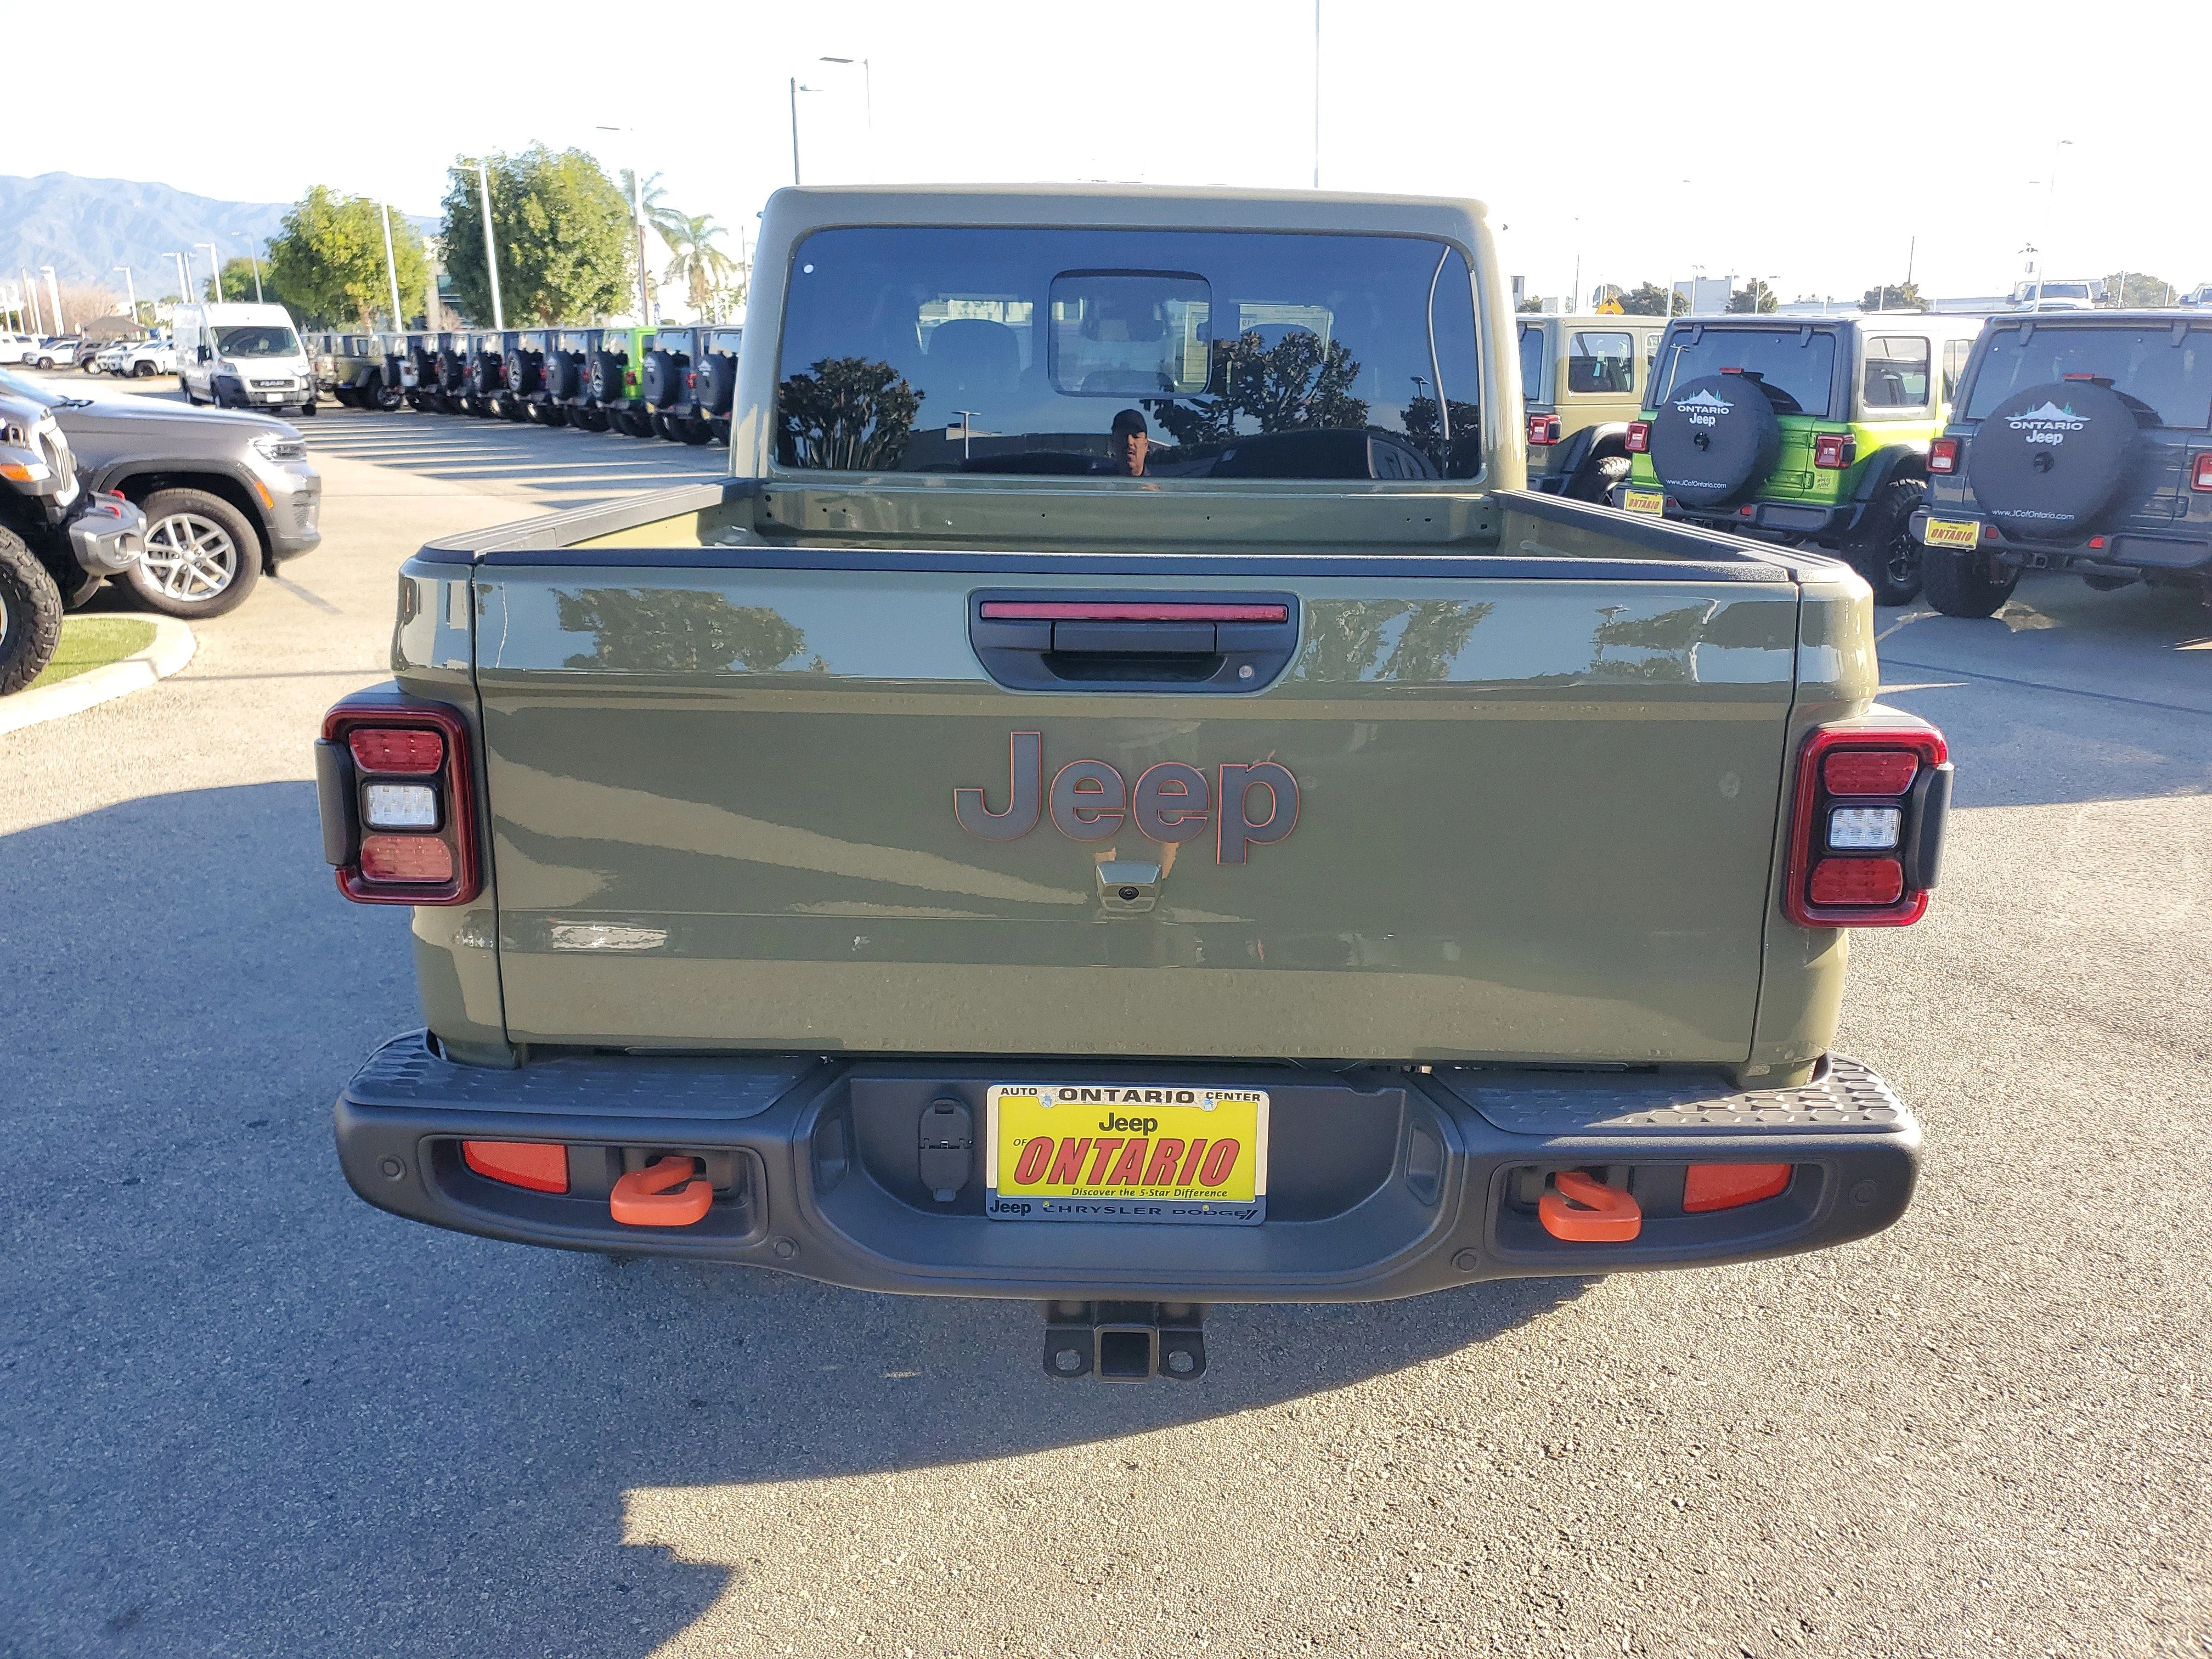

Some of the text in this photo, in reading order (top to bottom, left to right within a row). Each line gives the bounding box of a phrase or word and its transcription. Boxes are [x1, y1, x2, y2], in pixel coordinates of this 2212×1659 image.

[1677, 405, 1729, 414] ONTARIO
[1689, 413, 1716, 427] Jeep
[2010, 421, 2084, 431] ONTARIO
[2025, 430, 2063, 446] Jeep
[1666, 479, 1726, 489] www.JCofOntario.com
[1629, 499, 1660, 510] ONTARIO
[1992, 510, 2074, 520] www.JCofOntario.com
[1931, 528, 1973, 541] ONTARIO
[954, 731, 1300, 865] Jeep
[1001, 1087, 1260, 1104] AUTO ONTARIO CENTER
[1098, 1112, 1158, 1136] Jeep
[1013, 1136, 1240, 1187] OF ONTARIO
[1071, 1188, 1116, 1196] Discover
[1139, 1189, 1171, 1197] 5-Star
[1174, 1189, 1227, 1198] Difference
[989, 1200, 1032, 1216] Jeep
[1043, 1205, 1161, 1215] CHRYSLER
